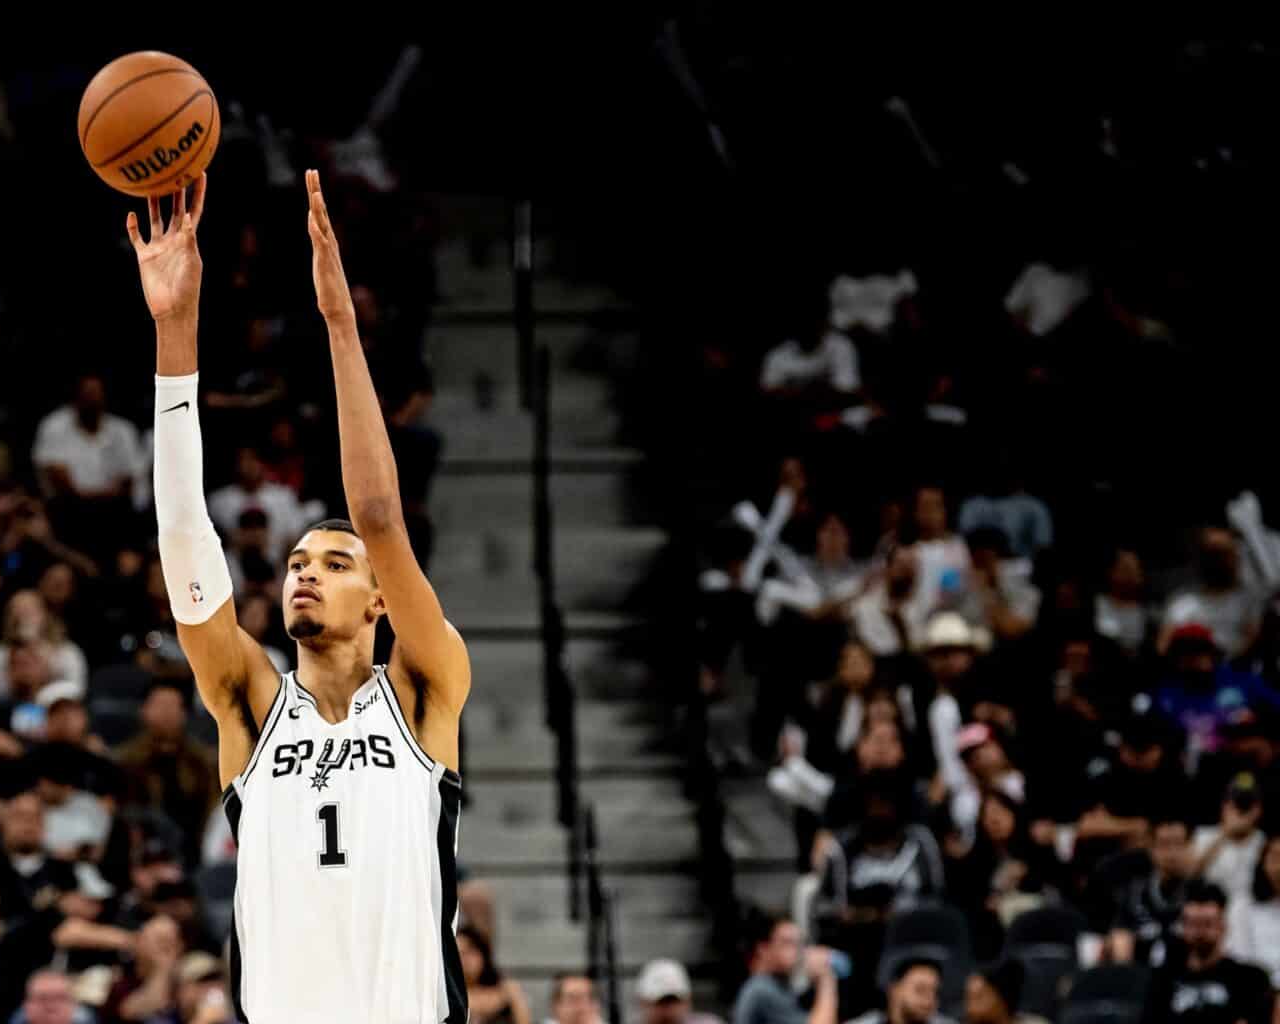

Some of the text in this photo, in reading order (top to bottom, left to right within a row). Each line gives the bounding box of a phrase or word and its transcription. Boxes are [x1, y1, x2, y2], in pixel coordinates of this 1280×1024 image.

[119, 121, 204, 183] Wilson
[272, 734, 396, 792] SPURS
[315, 801, 354, 870] 1
